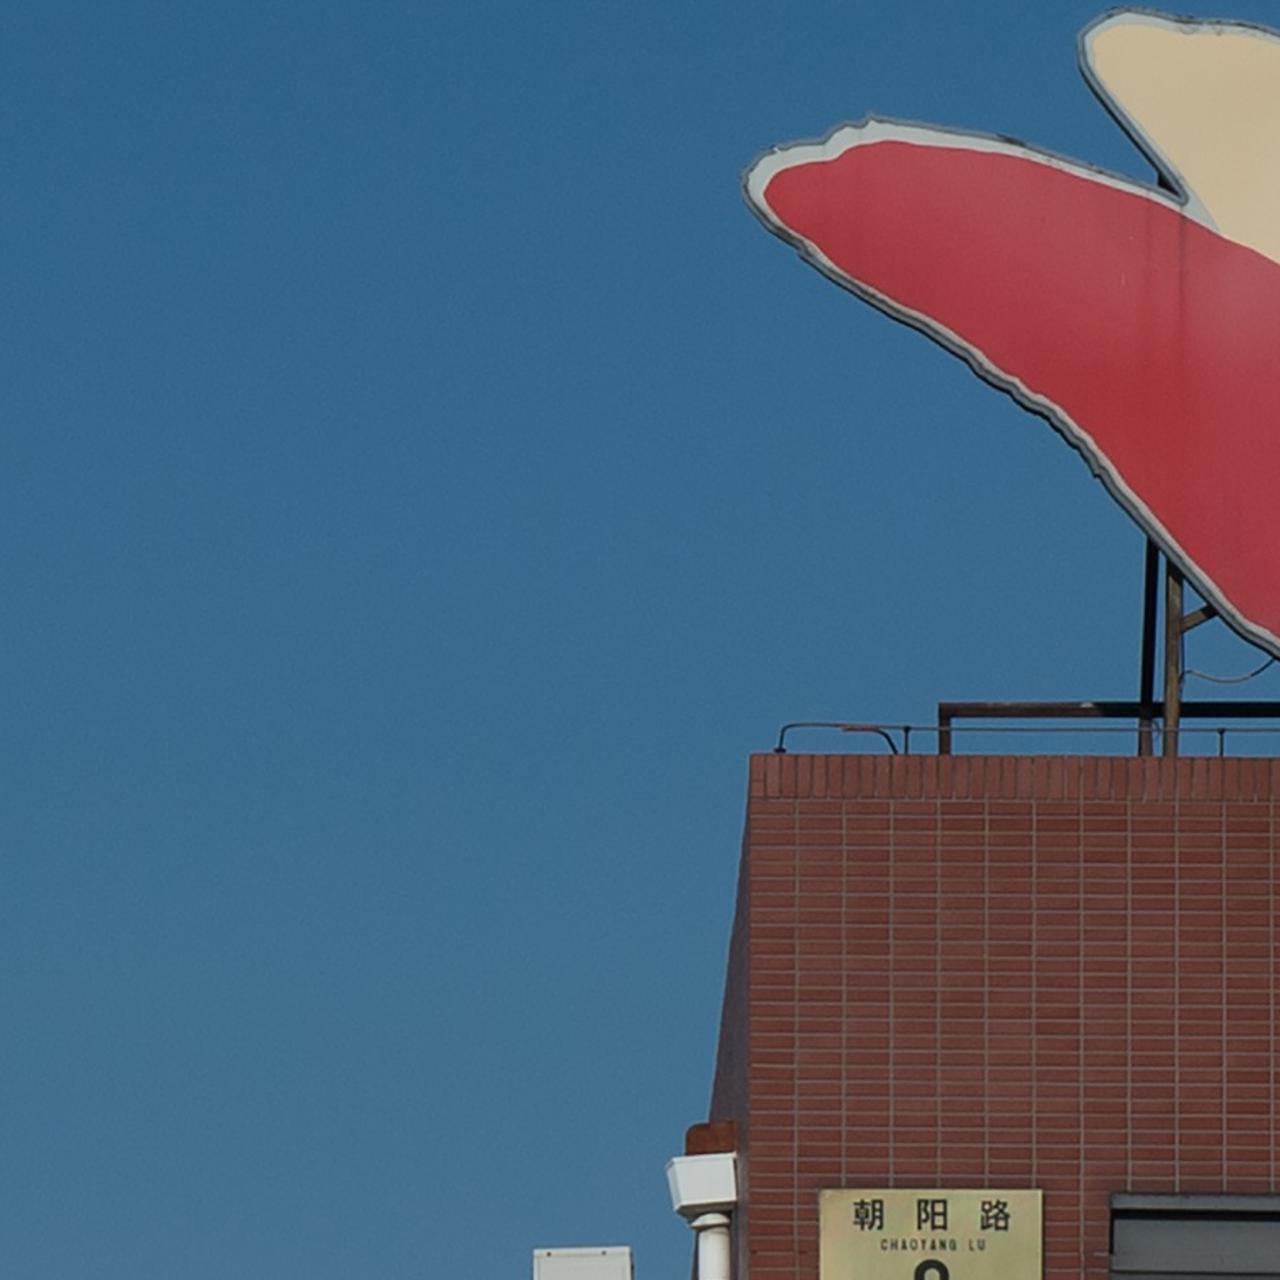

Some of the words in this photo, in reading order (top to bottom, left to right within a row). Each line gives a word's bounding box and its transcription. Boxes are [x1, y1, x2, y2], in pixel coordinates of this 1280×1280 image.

[853, 1199, 1011, 1231] 朝阳路
[881, 1238, 957, 1251] CHAOYANG
[969, 1239, 986, 1251] LU
